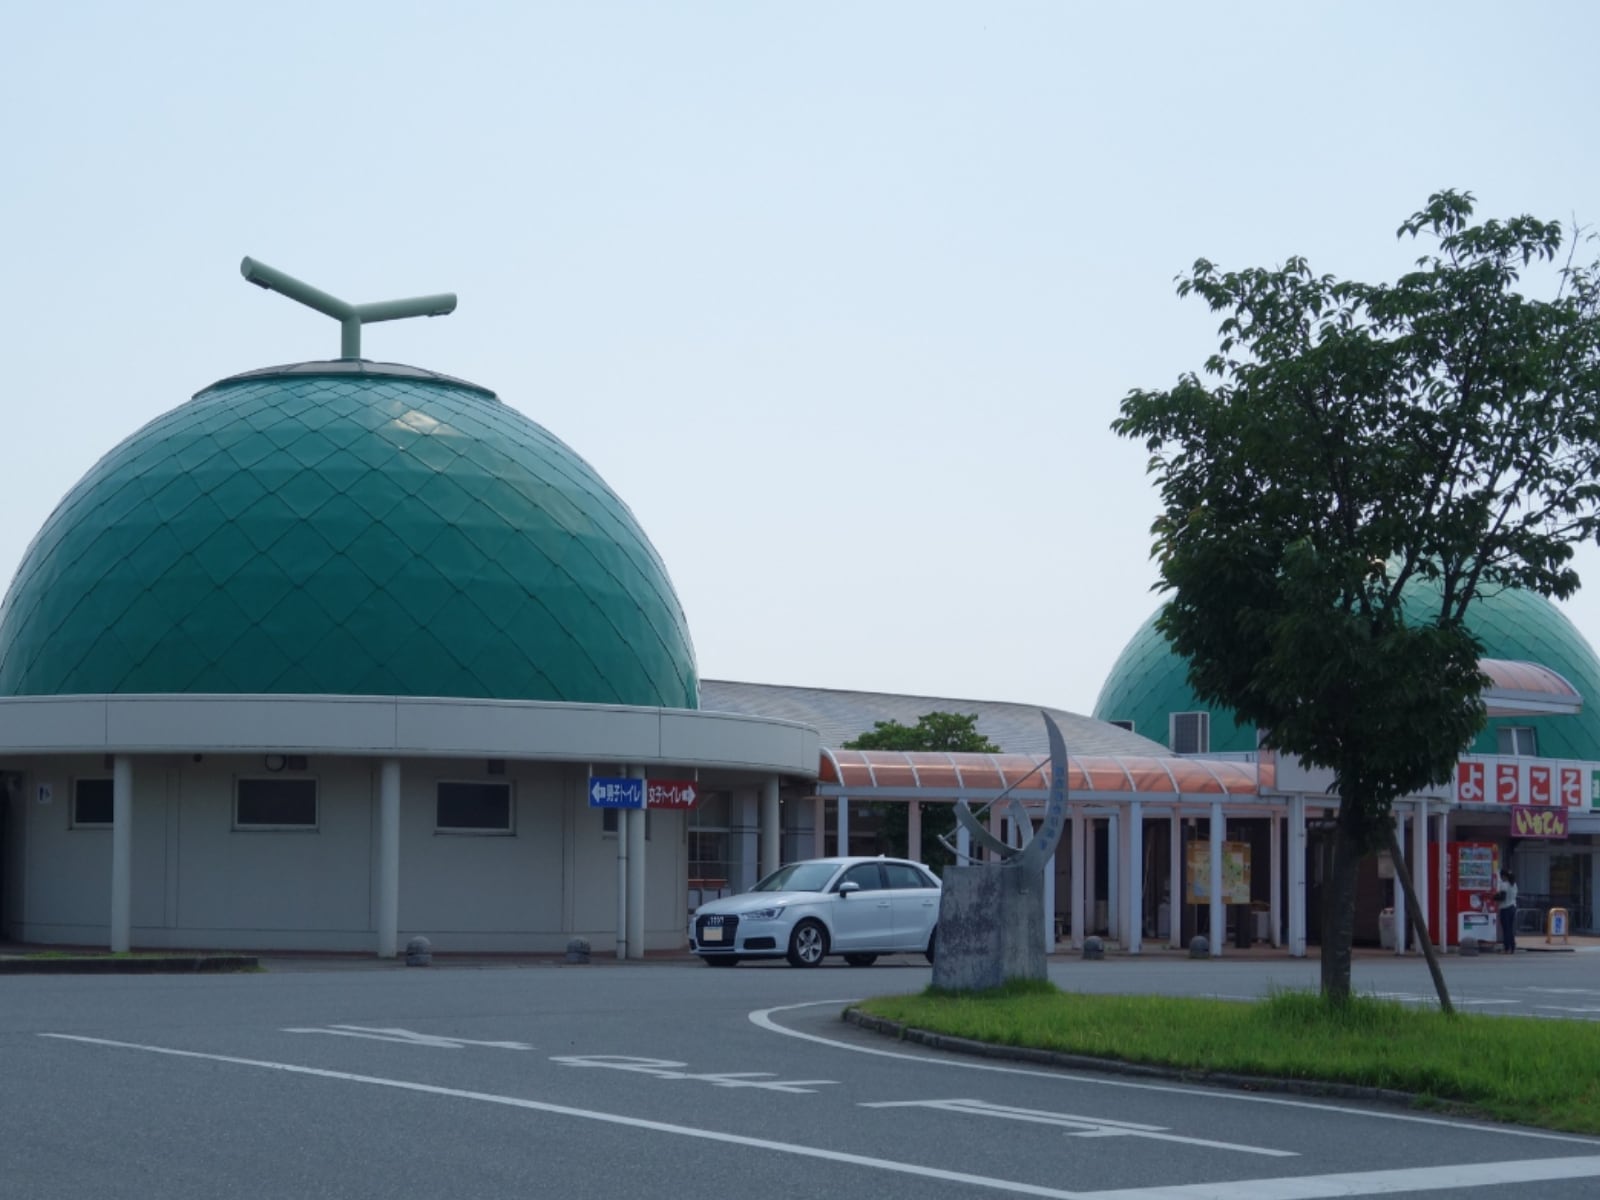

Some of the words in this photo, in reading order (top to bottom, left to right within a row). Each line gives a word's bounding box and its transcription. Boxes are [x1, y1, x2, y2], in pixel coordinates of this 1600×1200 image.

[607, 784, 641, 803] 男子トイレ
[1461, 765, 1580, 803] ようこそ
[648, 785, 682, 804] 女子トイレ
